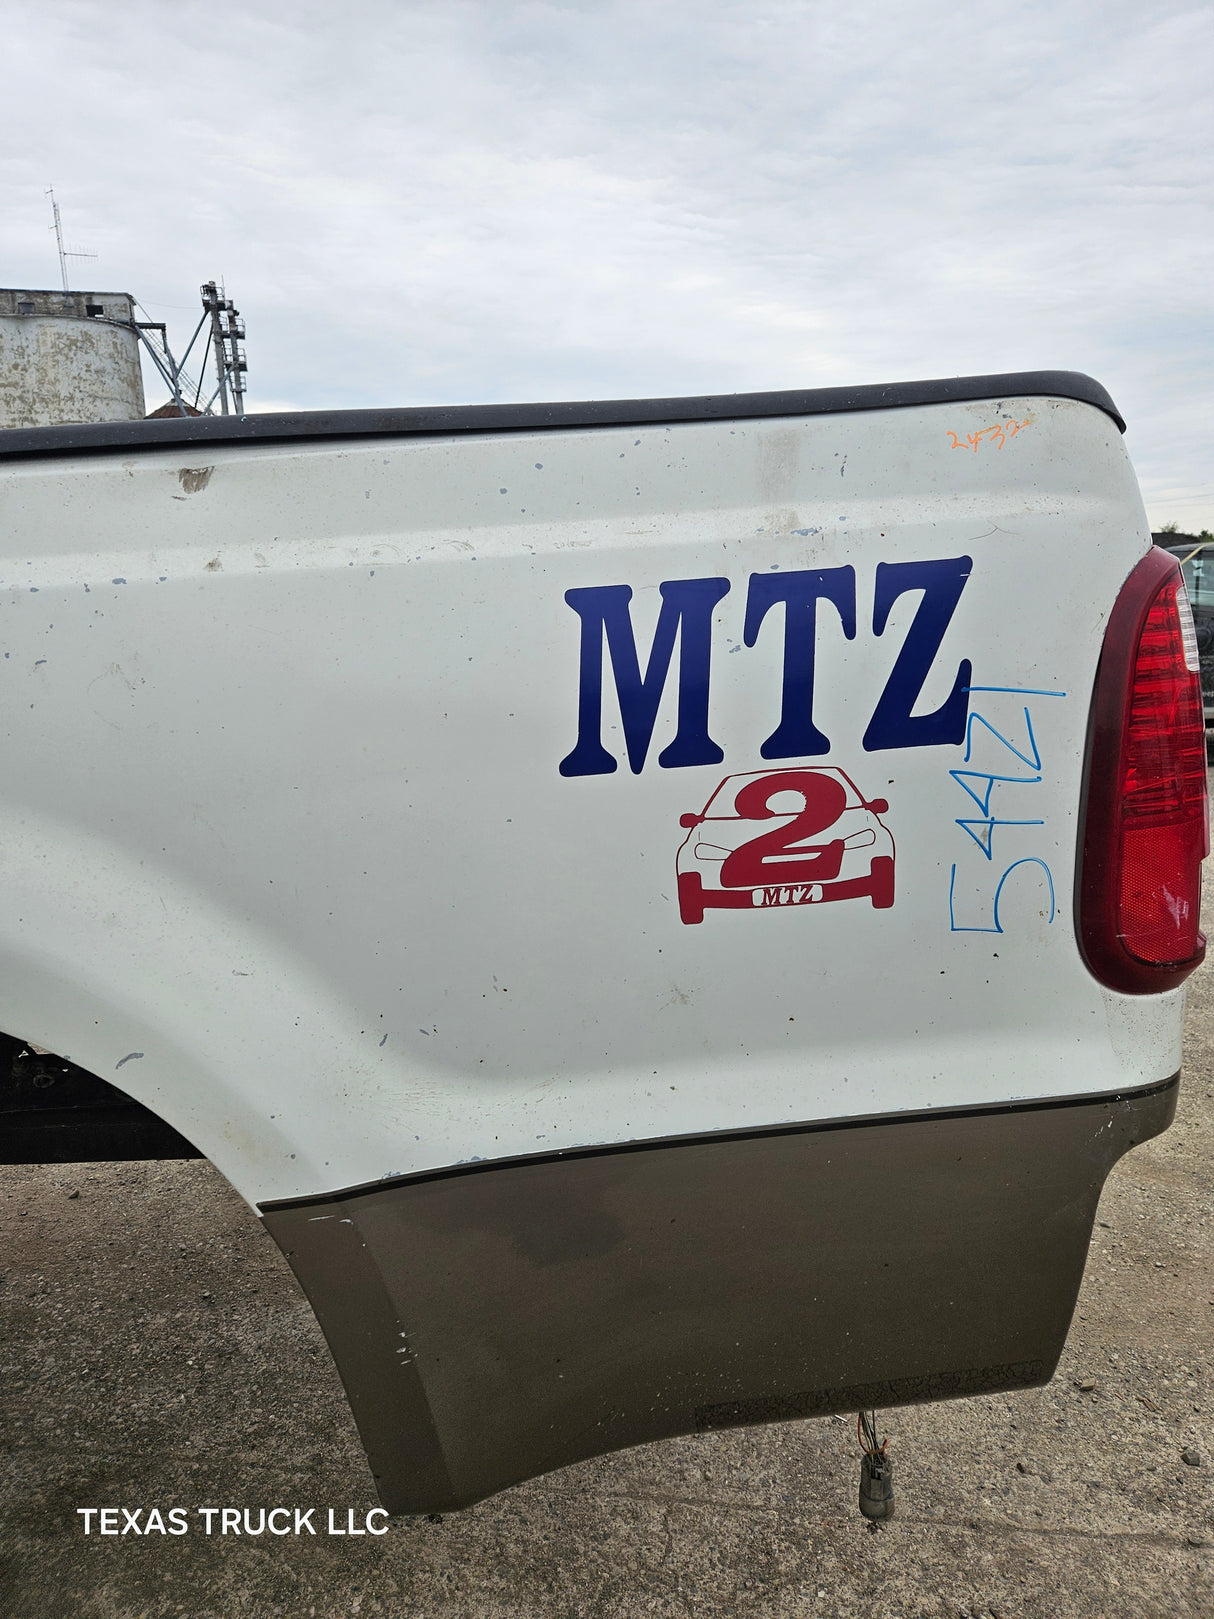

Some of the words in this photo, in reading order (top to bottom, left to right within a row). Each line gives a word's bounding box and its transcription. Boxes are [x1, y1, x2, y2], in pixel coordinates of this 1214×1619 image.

[946, 416, 1034, 453] 2432
[559, 555, 973, 778] MTZ
[720, 771, 847, 888] 2
[761, 884, 814, 906] MTZ
